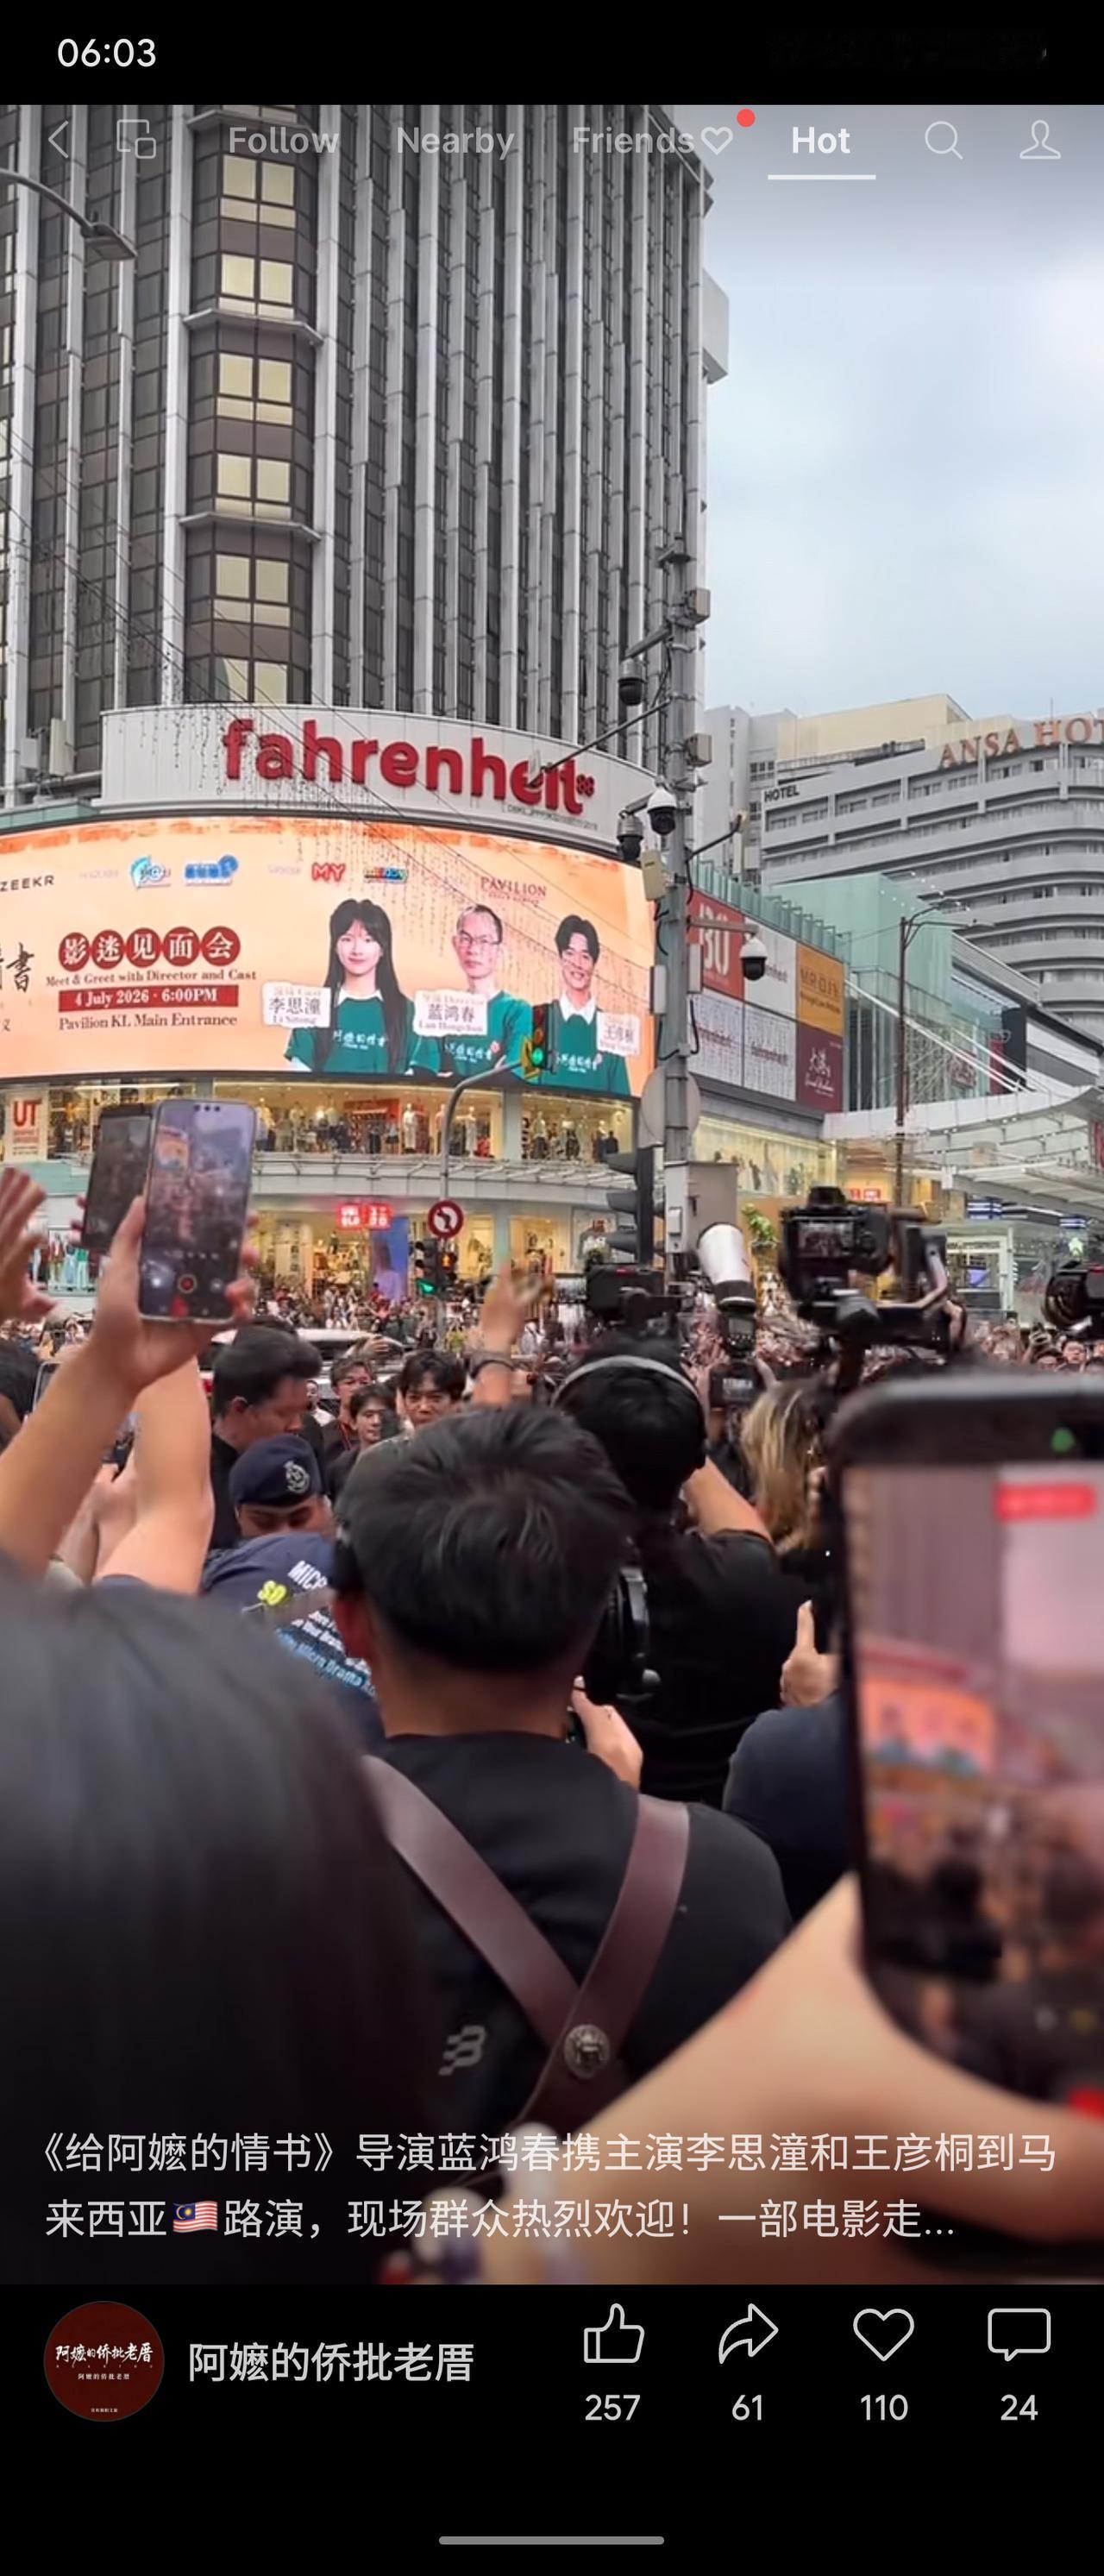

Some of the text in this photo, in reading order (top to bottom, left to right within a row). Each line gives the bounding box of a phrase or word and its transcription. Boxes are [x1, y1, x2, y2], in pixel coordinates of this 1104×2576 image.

[938, 728, 1021, 769] ANSA
[763, 785, 800, 803] HOTEL
[312, 864, 345, 882] MY
[0, 875, 55, 892] ZEEKR
[480, 876, 546, 896] PAVILION
[62, 931, 234, 966] 影迷见面会
[47, 976, 69, 987] Meet
[85, 973, 114, 984] Greet
[119, 971, 144, 983] with
[147, 970, 198, 982] Director
[201, 970, 224, 980] and
[229, 969, 257, 980] Cast
[85, 990, 112, 1008] July
[116, 989, 149, 1003] 2026
[161, 987, 218, 1002] 6:00PM
[269, 997, 322, 1015] 李思潼
[59, 1012, 237, 1030] Pavilion KL Main Entrance
[14, 1097, 42, 1127] UT
